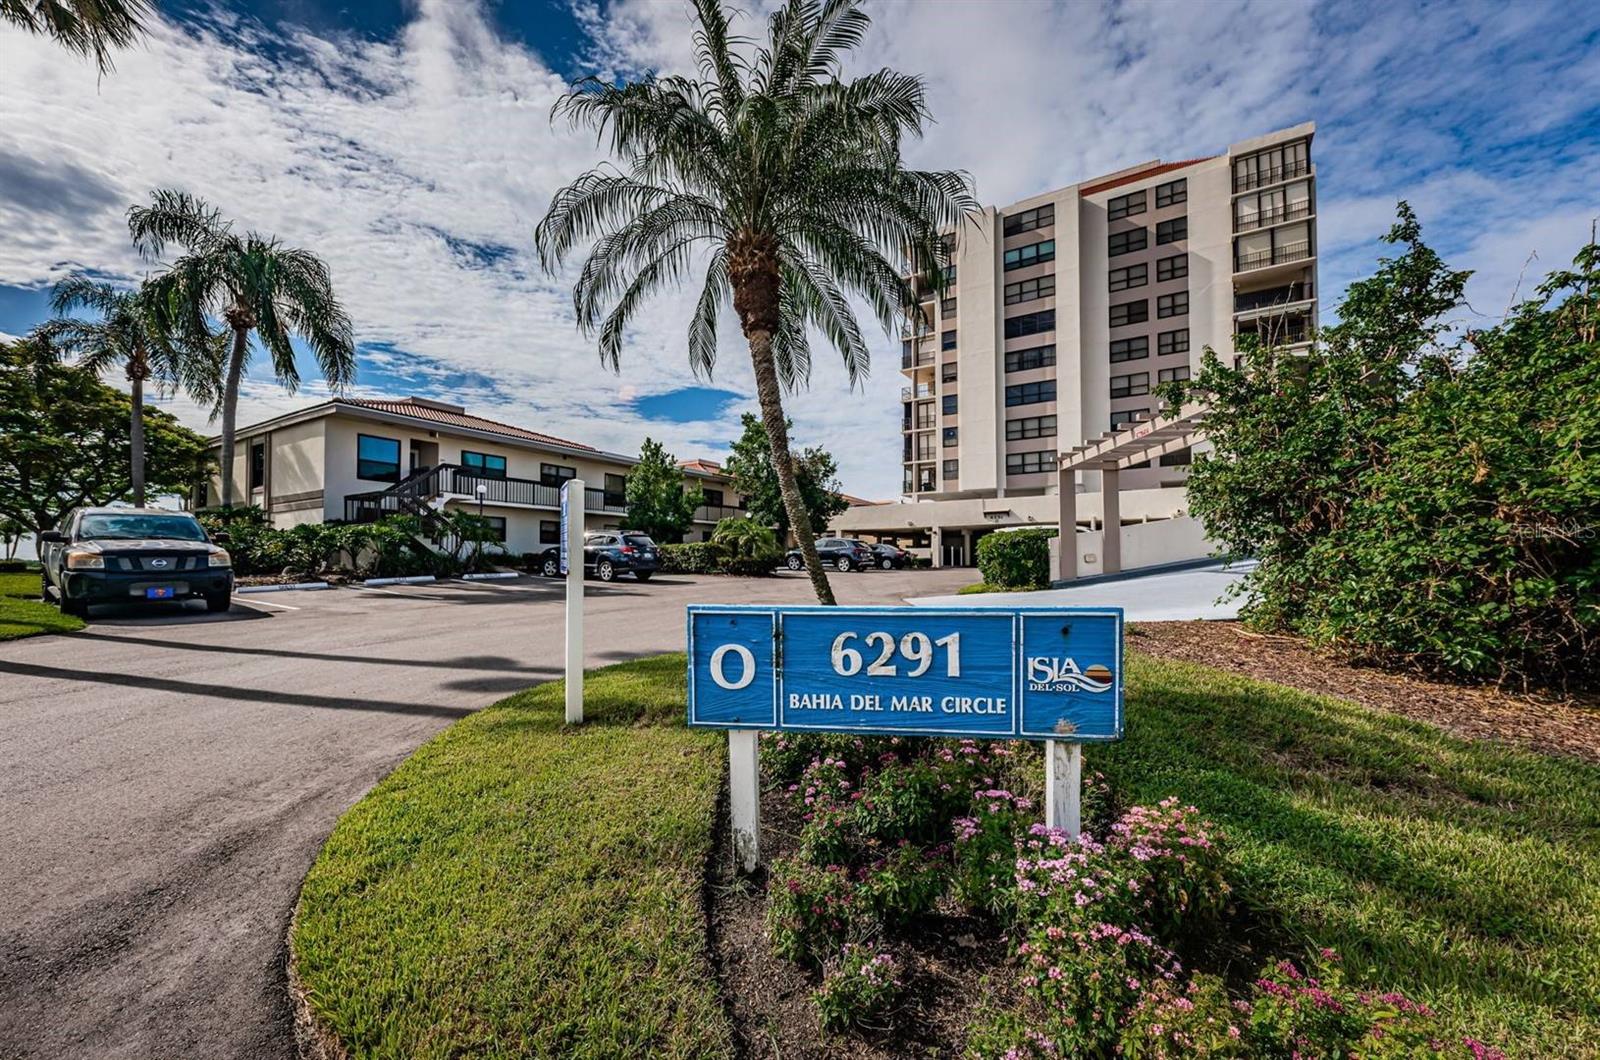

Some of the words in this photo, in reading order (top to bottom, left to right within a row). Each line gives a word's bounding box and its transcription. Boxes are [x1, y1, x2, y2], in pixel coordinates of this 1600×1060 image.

[709, 643, 756, 690] O
[831, 631, 961, 678] 6291
[789, 693, 843, 710] BAHIA
[850, 694, 884, 711] DEL
[890, 695, 933, 713] MAR
[941, 696, 1007, 714] CIRCLE
